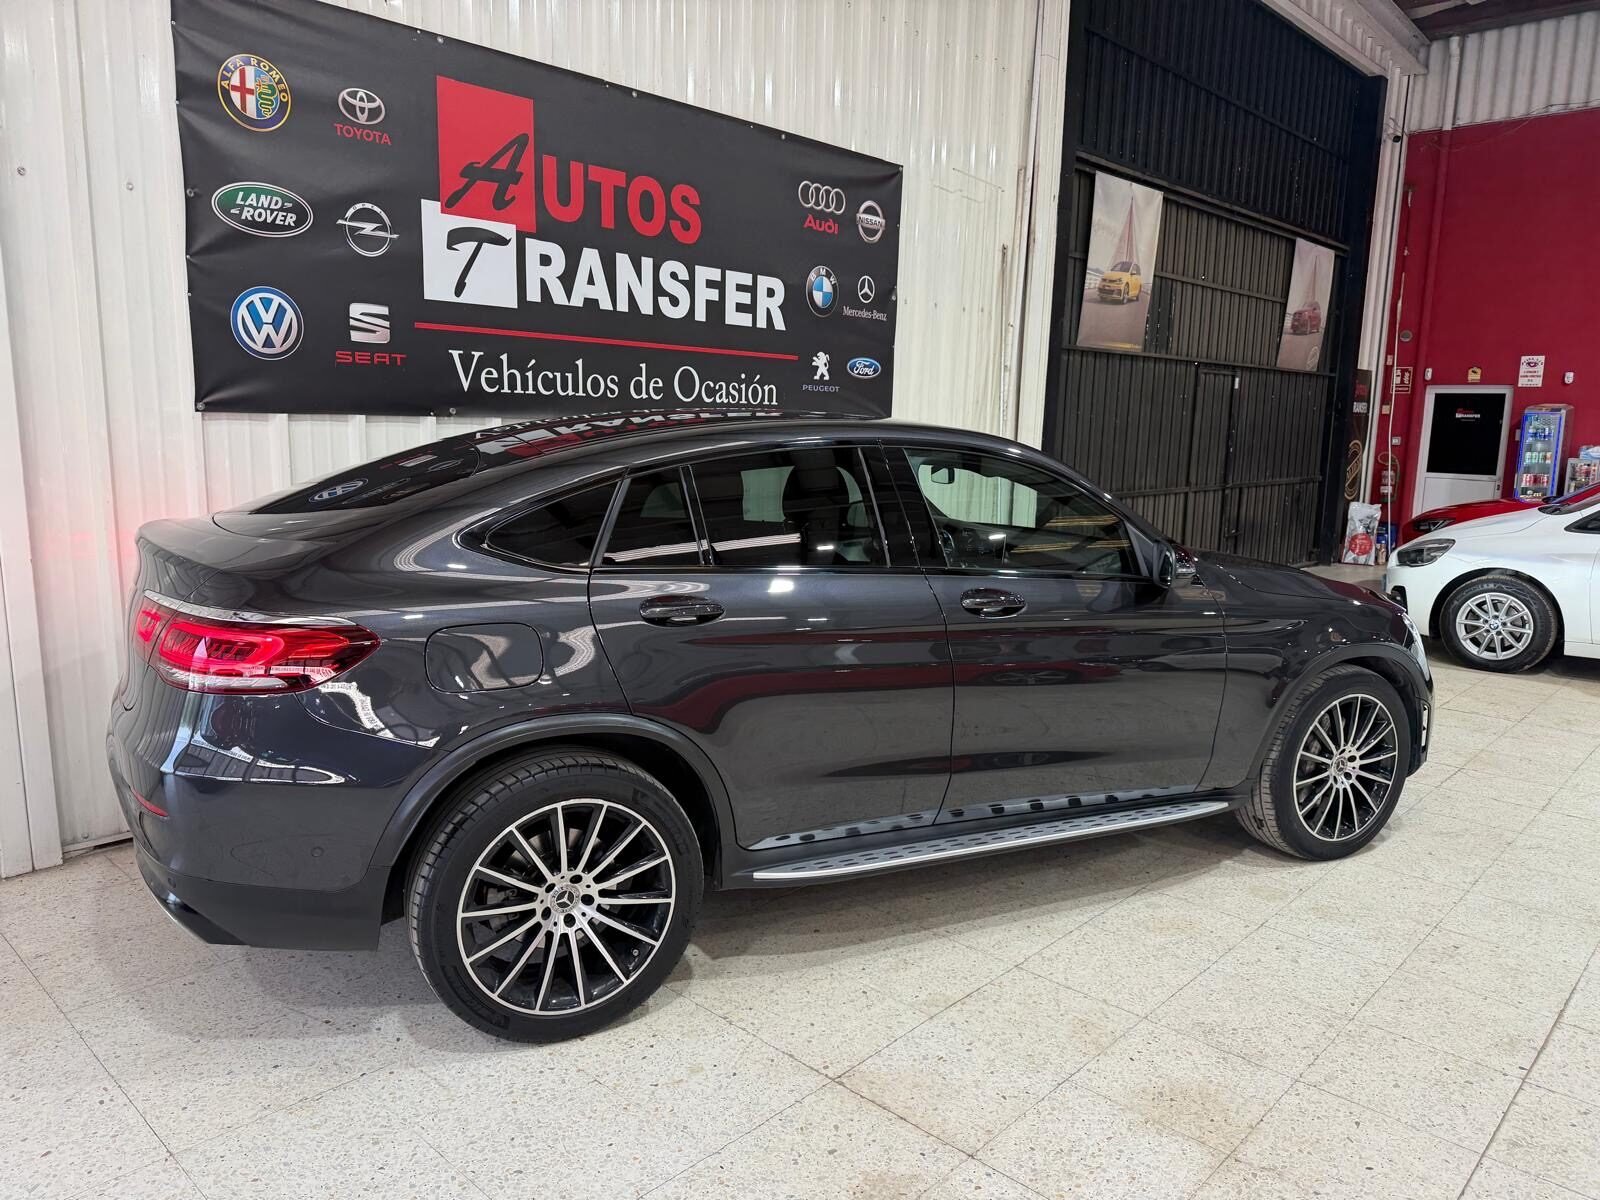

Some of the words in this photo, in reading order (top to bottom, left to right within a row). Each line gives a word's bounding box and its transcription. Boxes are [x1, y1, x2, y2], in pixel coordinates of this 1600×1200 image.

[221, 58, 245, 90] ALFA
[250, 57, 288, 103] ROMEO
[334, 123, 392, 146] TOYOTA
[444, 133, 702, 244] AUTOS
[235, 191, 283, 210] LAND
[241, 208, 297, 227] ROVER
[803, 214, 839, 234] Audi
[858, 215, 883, 227] NISSAN
[446, 226, 786, 331] TRANSFER
[842, 305, 887, 321] Mercedes-Benz
[335, 350, 406, 366] SEAT
[853, 360, 875, 375] Ford
[448, 349, 619, 400] Vehículos
[629, 363, 664, 401] de
[673, 365, 779, 406] Ocasión
[802, 384, 840, 392] PEUGEOT
